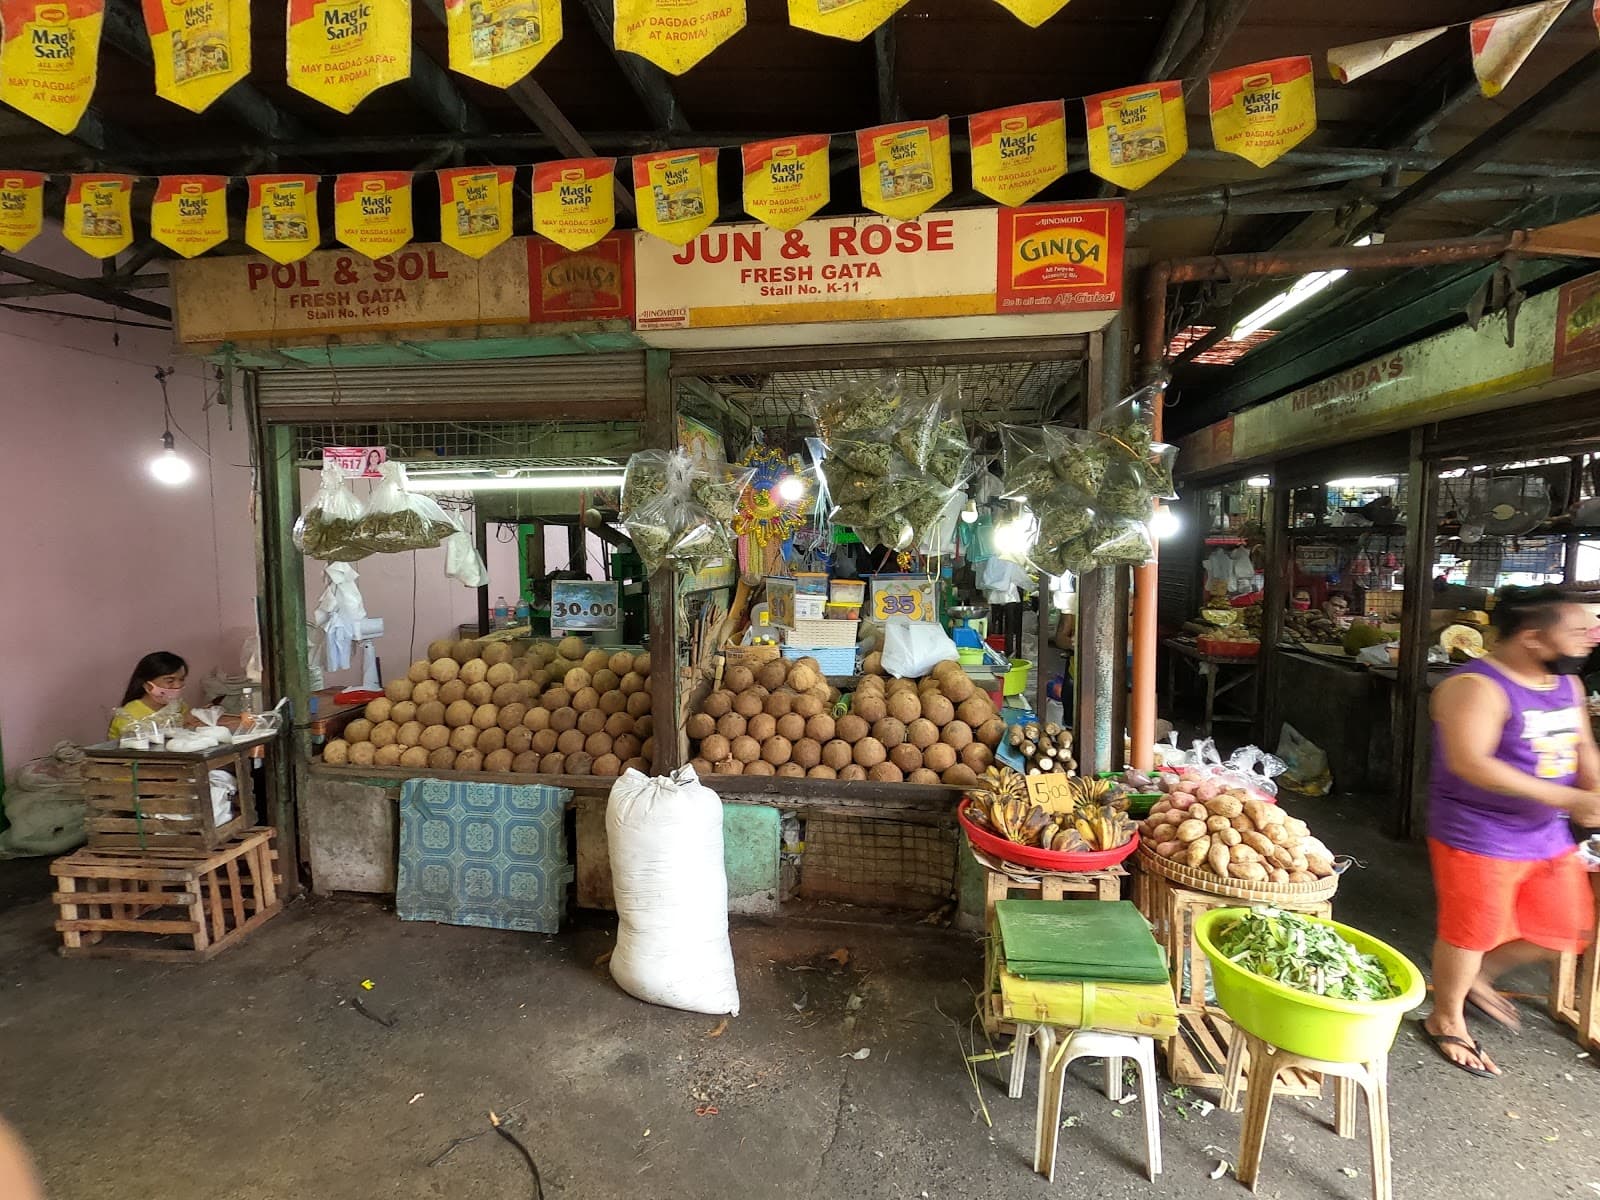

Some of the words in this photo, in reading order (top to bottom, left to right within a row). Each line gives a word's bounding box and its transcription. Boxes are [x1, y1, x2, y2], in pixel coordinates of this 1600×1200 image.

[324, 4, 371, 26] Magic
[627, 19, 646, 33] MAY
[649, 17, 697, 28] DAGDAG
[700, 7, 732, 24] SARAP
[327, 21, 367, 40] Sarap
[649, 31, 661, 40] AT
[32, 28, 76, 48] Magic
[301, 63, 321, 73] MAY
[324, 58, 362, 72] DAGDAG
[8, 77, 29, 87] MAY
[324, 76, 335, 84] AT
[1243, 89, 1281, 106] Magic
[1119, 103, 1148, 121] Magic
[1245, 103, 1279, 115] Sarap
[1121, 113, 1147, 126] Sarap
[1000, 132, 1038, 149] Magic
[1225, 133, 1243, 142] MAY
[890, 140, 917, 156] Magic
[1000, 145, 1035, 159] Sarap
[892, 149, 916, 162] Sarap
[664, 167, 689, 181] Magic
[770, 160, 805, 175] Magic
[666, 176, 689, 187] Sarap
[771, 173, 803, 184] Sarap
[467, 183, 487, 196] Magic
[560, 184, 593, 197] Magic
[179, 196, 208, 209] Magic
[273, 191, 296, 204] Magic
[273, 200, 296, 209] Sarap
[362, 195, 392, 209] Magic
[561, 195, 591, 206] Sarap
[179, 208, 207, 217] Sarap
[362, 206, 391, 216] Sarap
[672, 231, 761, 265] JUN
[780, 228, 812, 260] &
[829, 219, 954, 257] ROSE
[1020, 238, 1100, 264] GINISA
[247, 261, 320, 291] POL
[334, 256, 360, 285] &
[373, 250, 448, 283] SOL
[740, 266, 813, 284] FRESH
[821, 262, 882, 280] GATA
[760, 285, 793, 296] Stall
[798, 284, 821, 295] No.
[827, 281, 859, 293] K-11
[289, 292, 351, 309] FRESH
[356, 288, 407, 305] GATA
[307, 309, 336, 320] Stall
[338, 308, 358, 319] No.
[362, 306, 390, 318] K-19
[638, 308, 687, 318] AJINOMOTO
[553, 602, 616, 617] 30.00
[883, 595, 916, 614] 35
